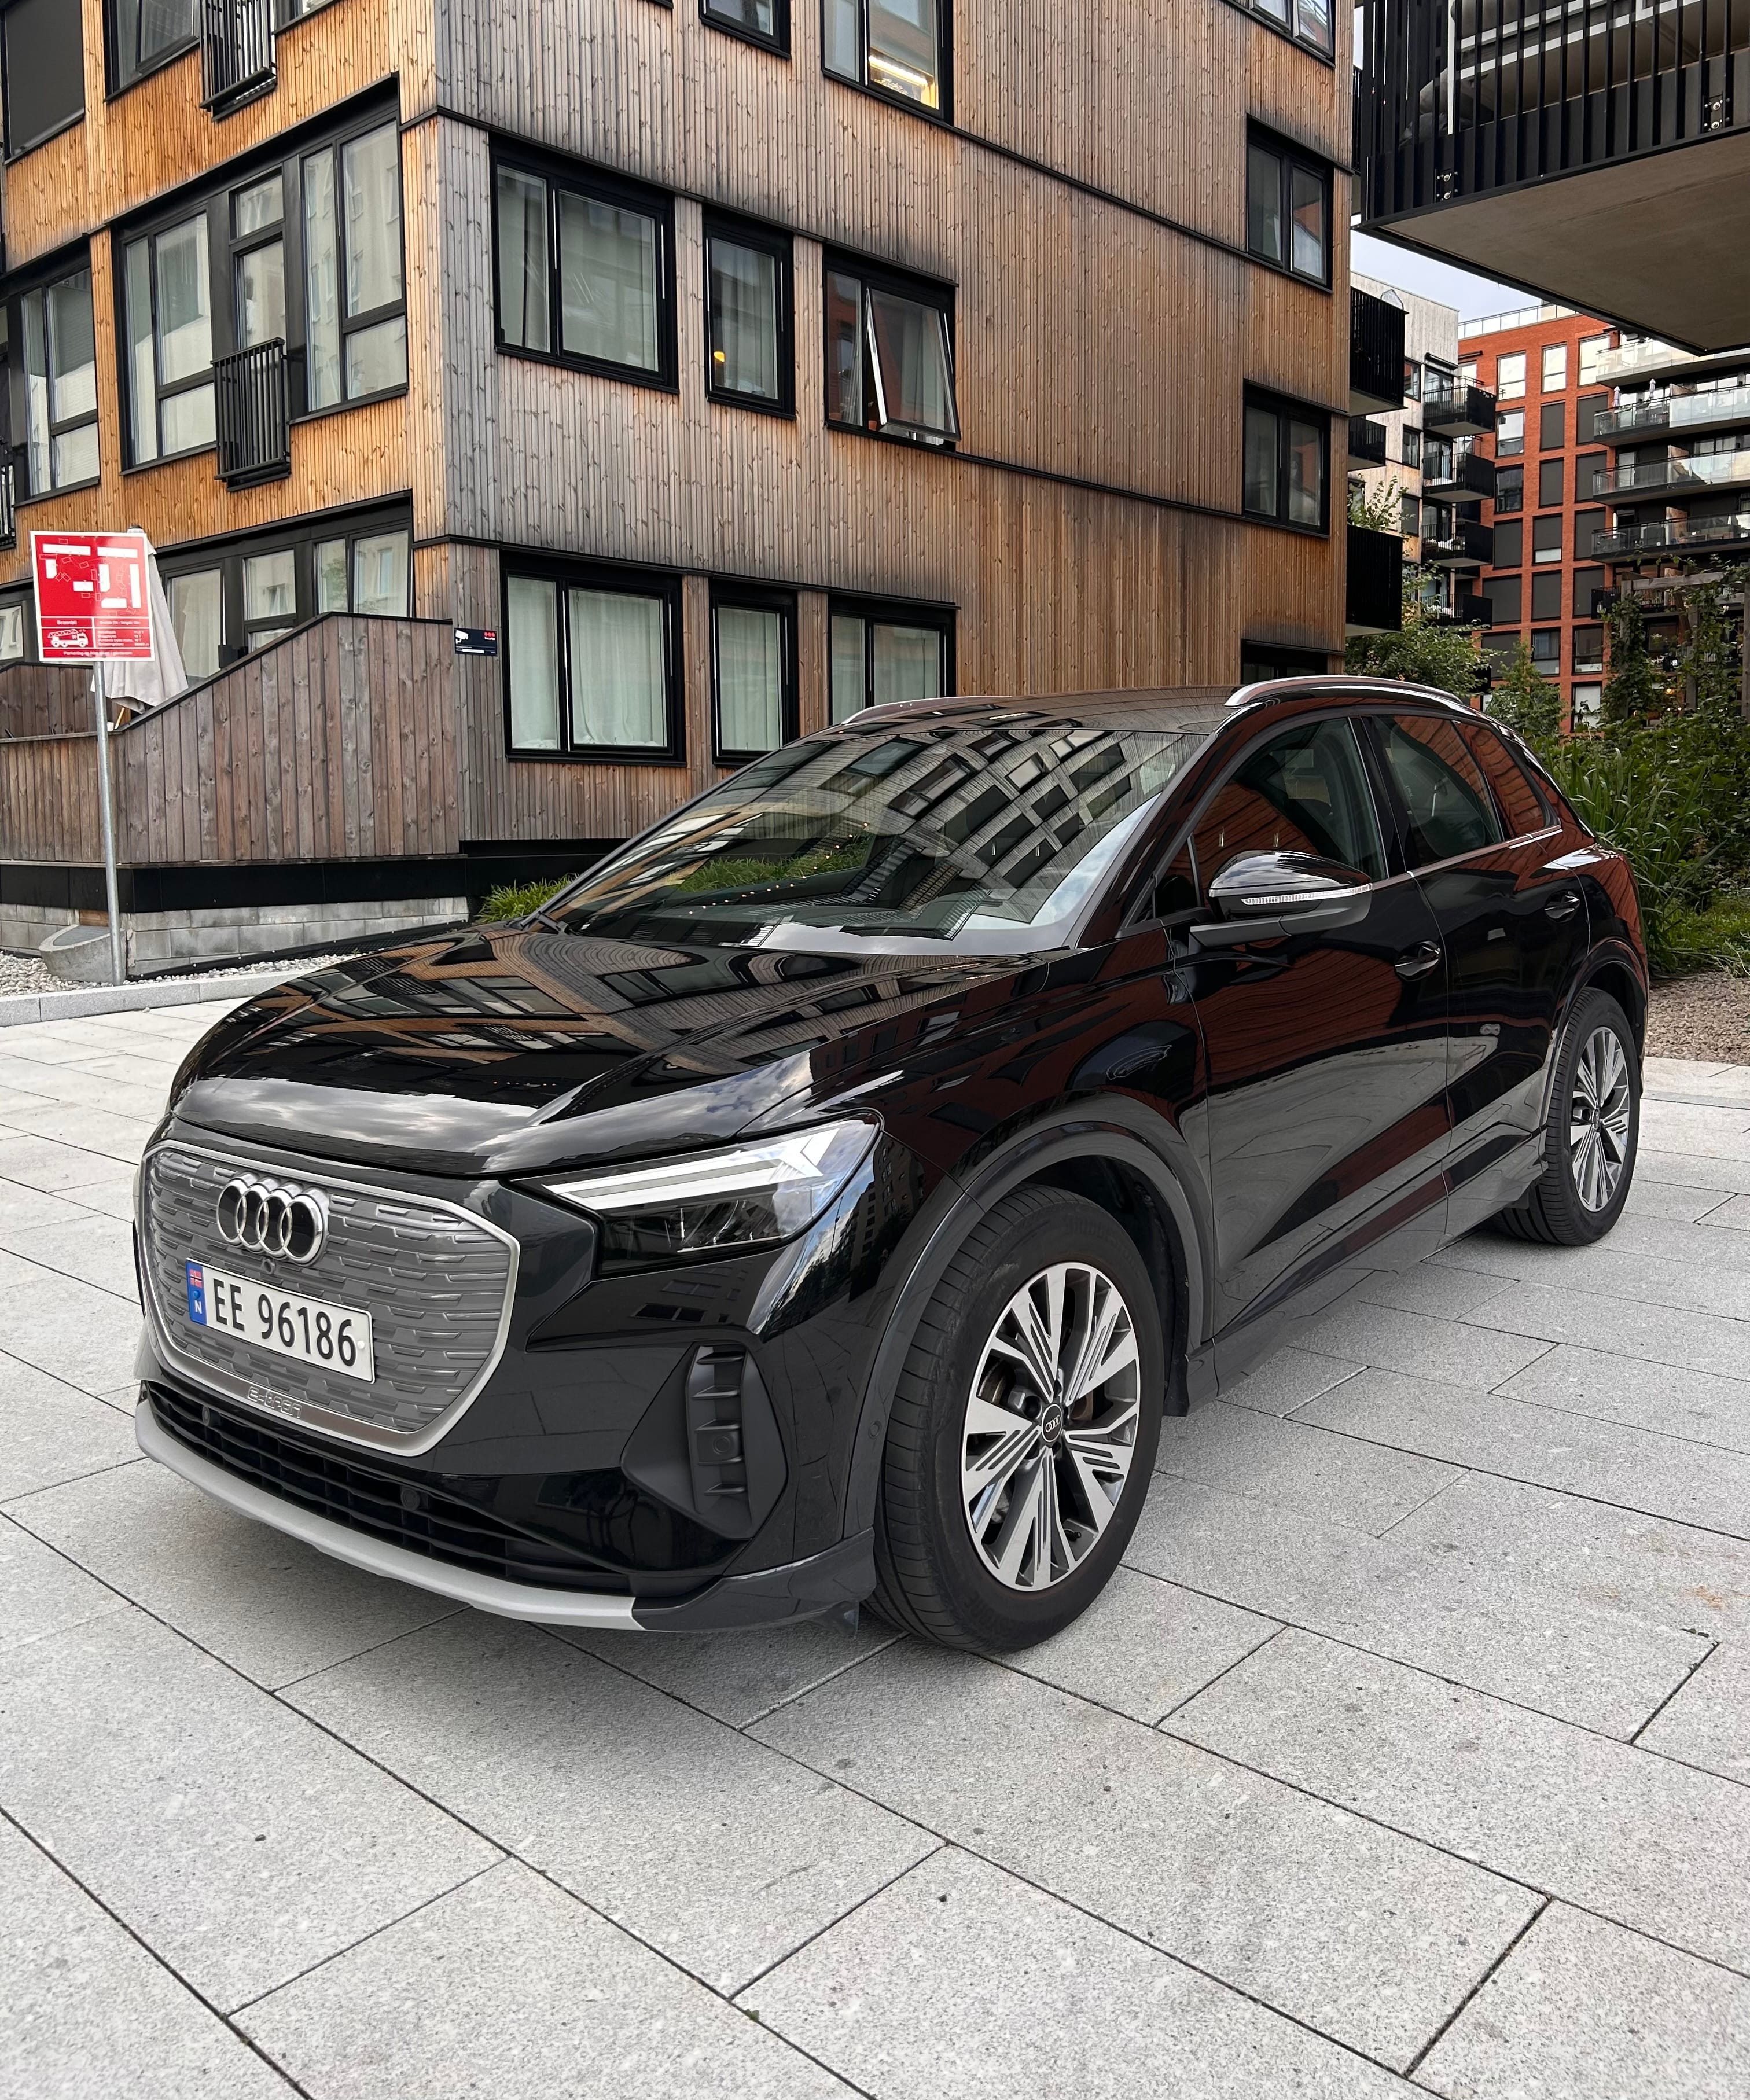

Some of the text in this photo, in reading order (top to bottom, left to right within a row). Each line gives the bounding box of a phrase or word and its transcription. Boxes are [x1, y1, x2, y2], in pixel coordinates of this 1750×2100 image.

[194, 1300, 202, 1315] N
[213, 1278, 356, 1367] EE 96186
